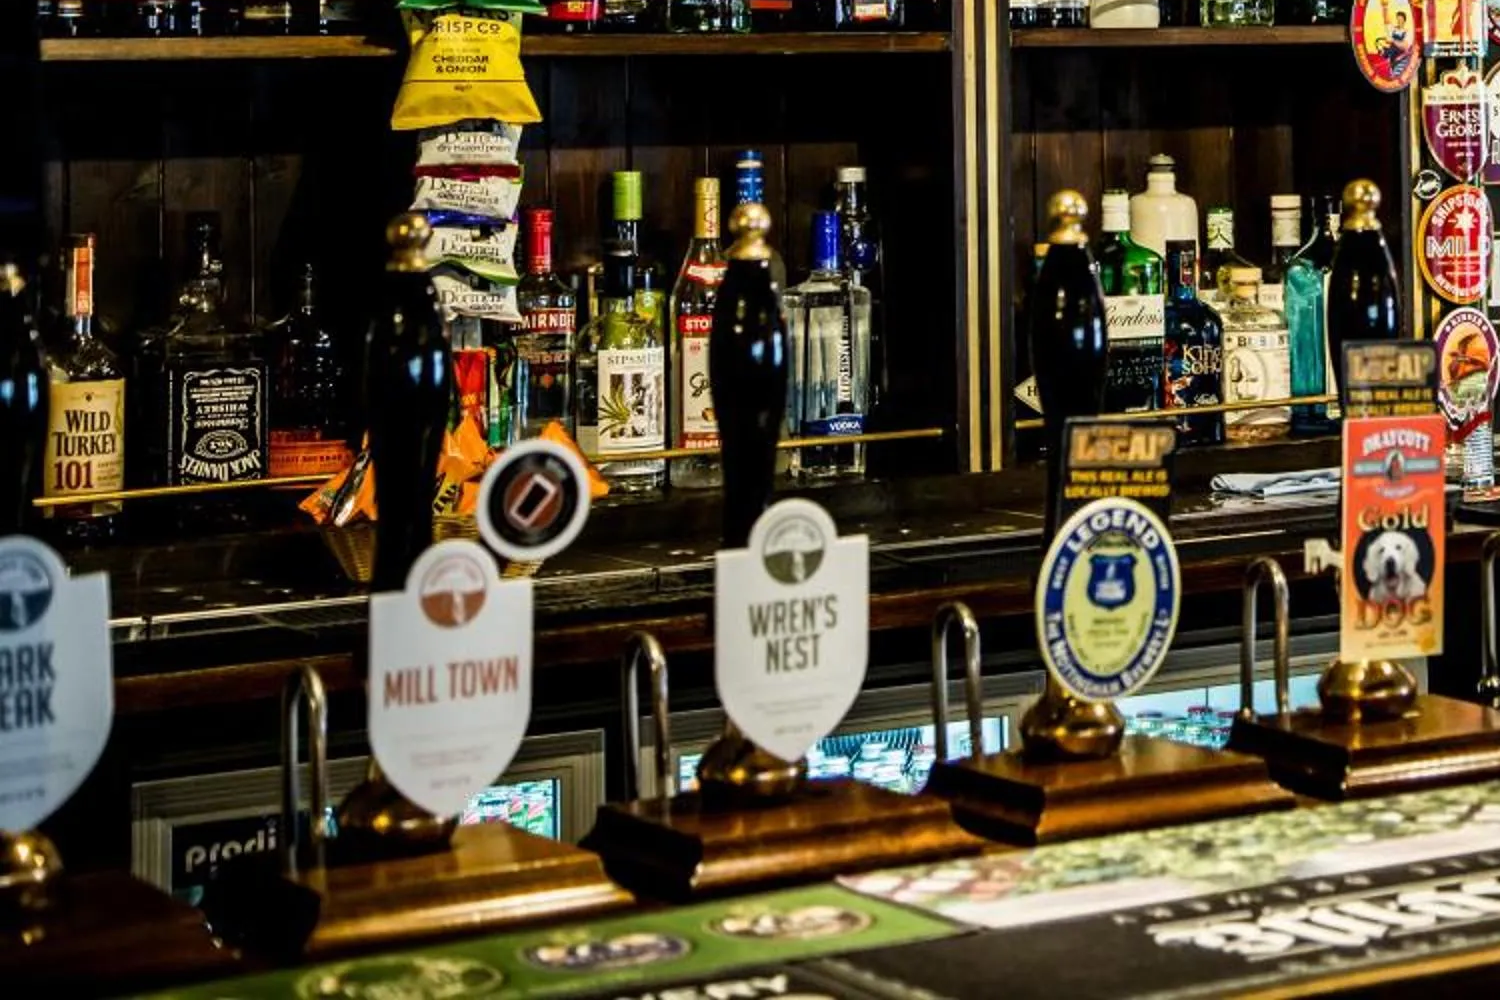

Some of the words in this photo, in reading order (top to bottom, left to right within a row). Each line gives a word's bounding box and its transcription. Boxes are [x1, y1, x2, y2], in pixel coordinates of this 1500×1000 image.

[434, 20, 473, 34] RISP
[431, 54, 490, 65] CHEDDAR
[1104, 303, 1165, 330] Gordon's
[64, 409, 112, 433] WILD
[53, 431, 118, 457] TURKEY
[53, 460, 95, 491] 101
[1066, 508, 1160, 553] LEGEND
[748, 595, 839, 638] WREN'S
[0, 641, 58, 684] ARK
[764, 633, 821, 676] NEST
[383, 667, 439, 708] MILL
[447, 655, 519, 700] TOWN
[0, 684, 57, 732] EAK
